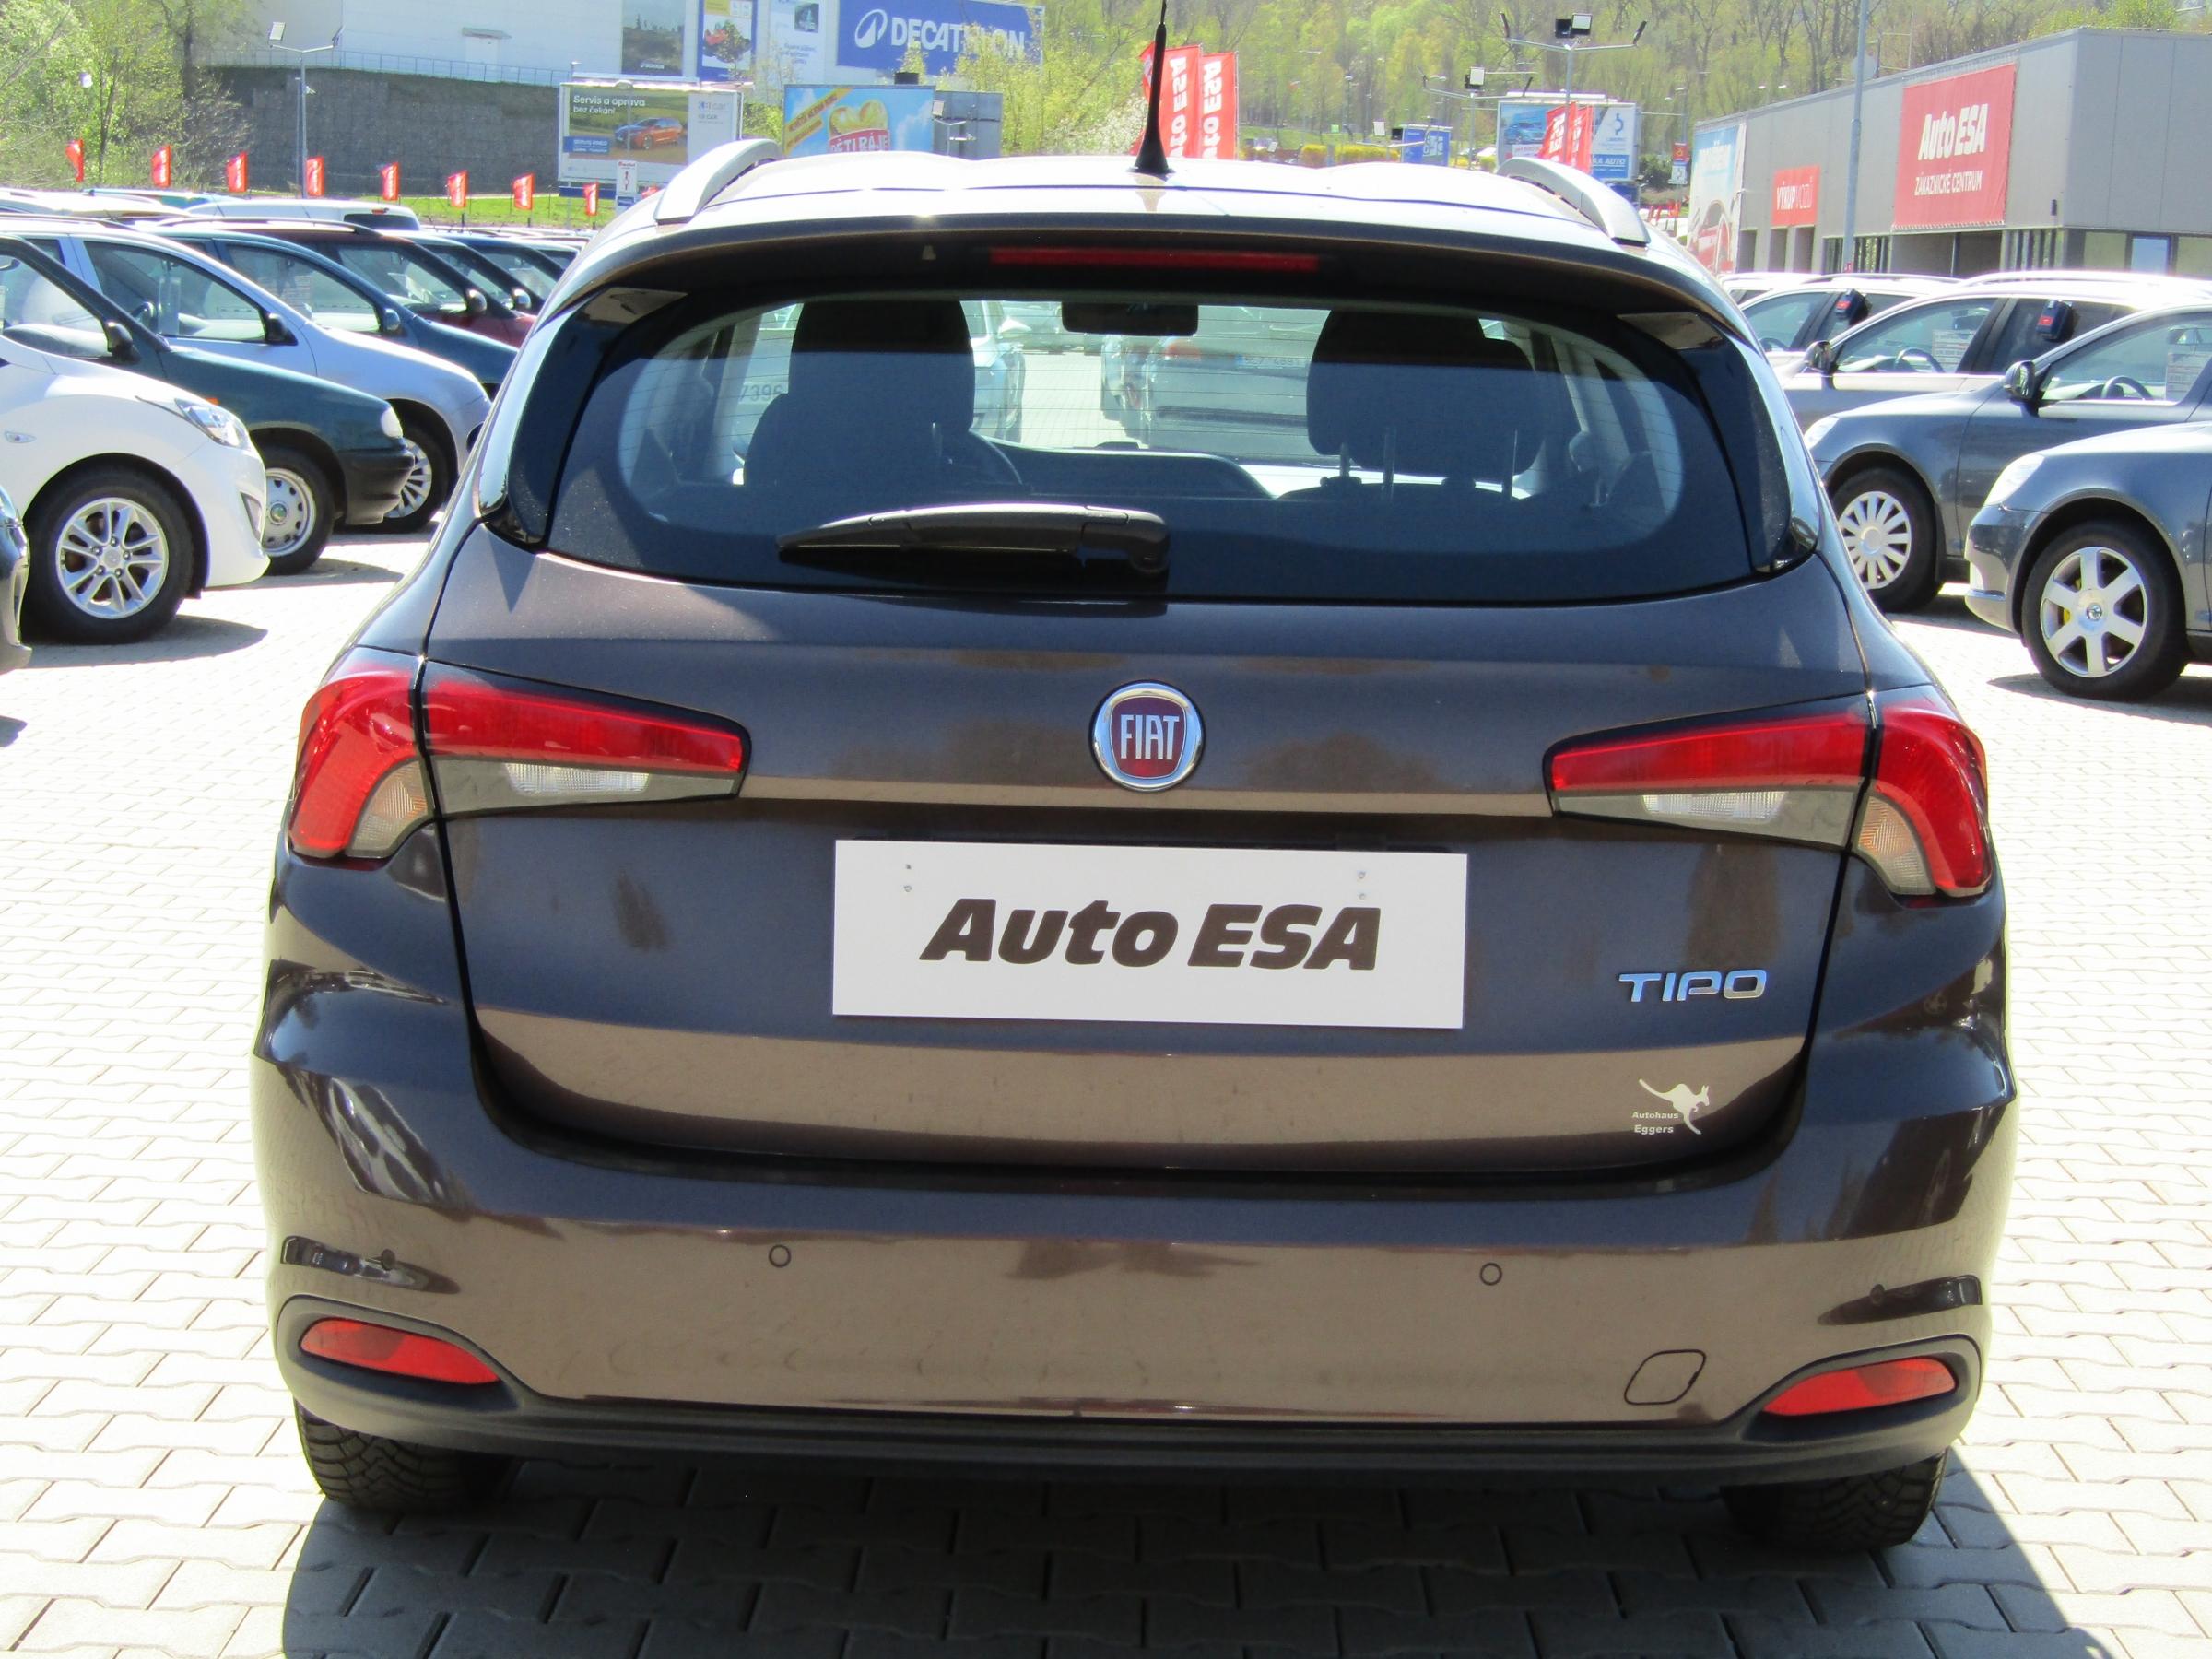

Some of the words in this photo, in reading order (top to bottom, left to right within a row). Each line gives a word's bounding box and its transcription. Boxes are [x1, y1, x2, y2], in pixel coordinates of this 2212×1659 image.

[891, 17, 1026, 59] DECATON
[573, 95, 602, 105] Servis
[573, 105, 587, 113] bez
[1918, 111, 1955, 160] Auto
[1954, 103, 1988, 156] ESA
[1776, 181, 1796, 211] VÝKUP
[1795, 175, 1814, 210] VOZŮ
[1914, 169, 1952, 196] ZÁKAZNICKÉ
[1951, 170, 1983, 194] CENTRUM
[1121, 714, 1180, 760] FIAT
[919, 898, 1179, 968] Auto
[1187, 903, 1382, 971] ESA
[1618, 969, 1768, 1003] TIPO
[1632, 1112, 1679, 1120] Autohaus
[1634, 1124, 1674, 1135] Eggers
